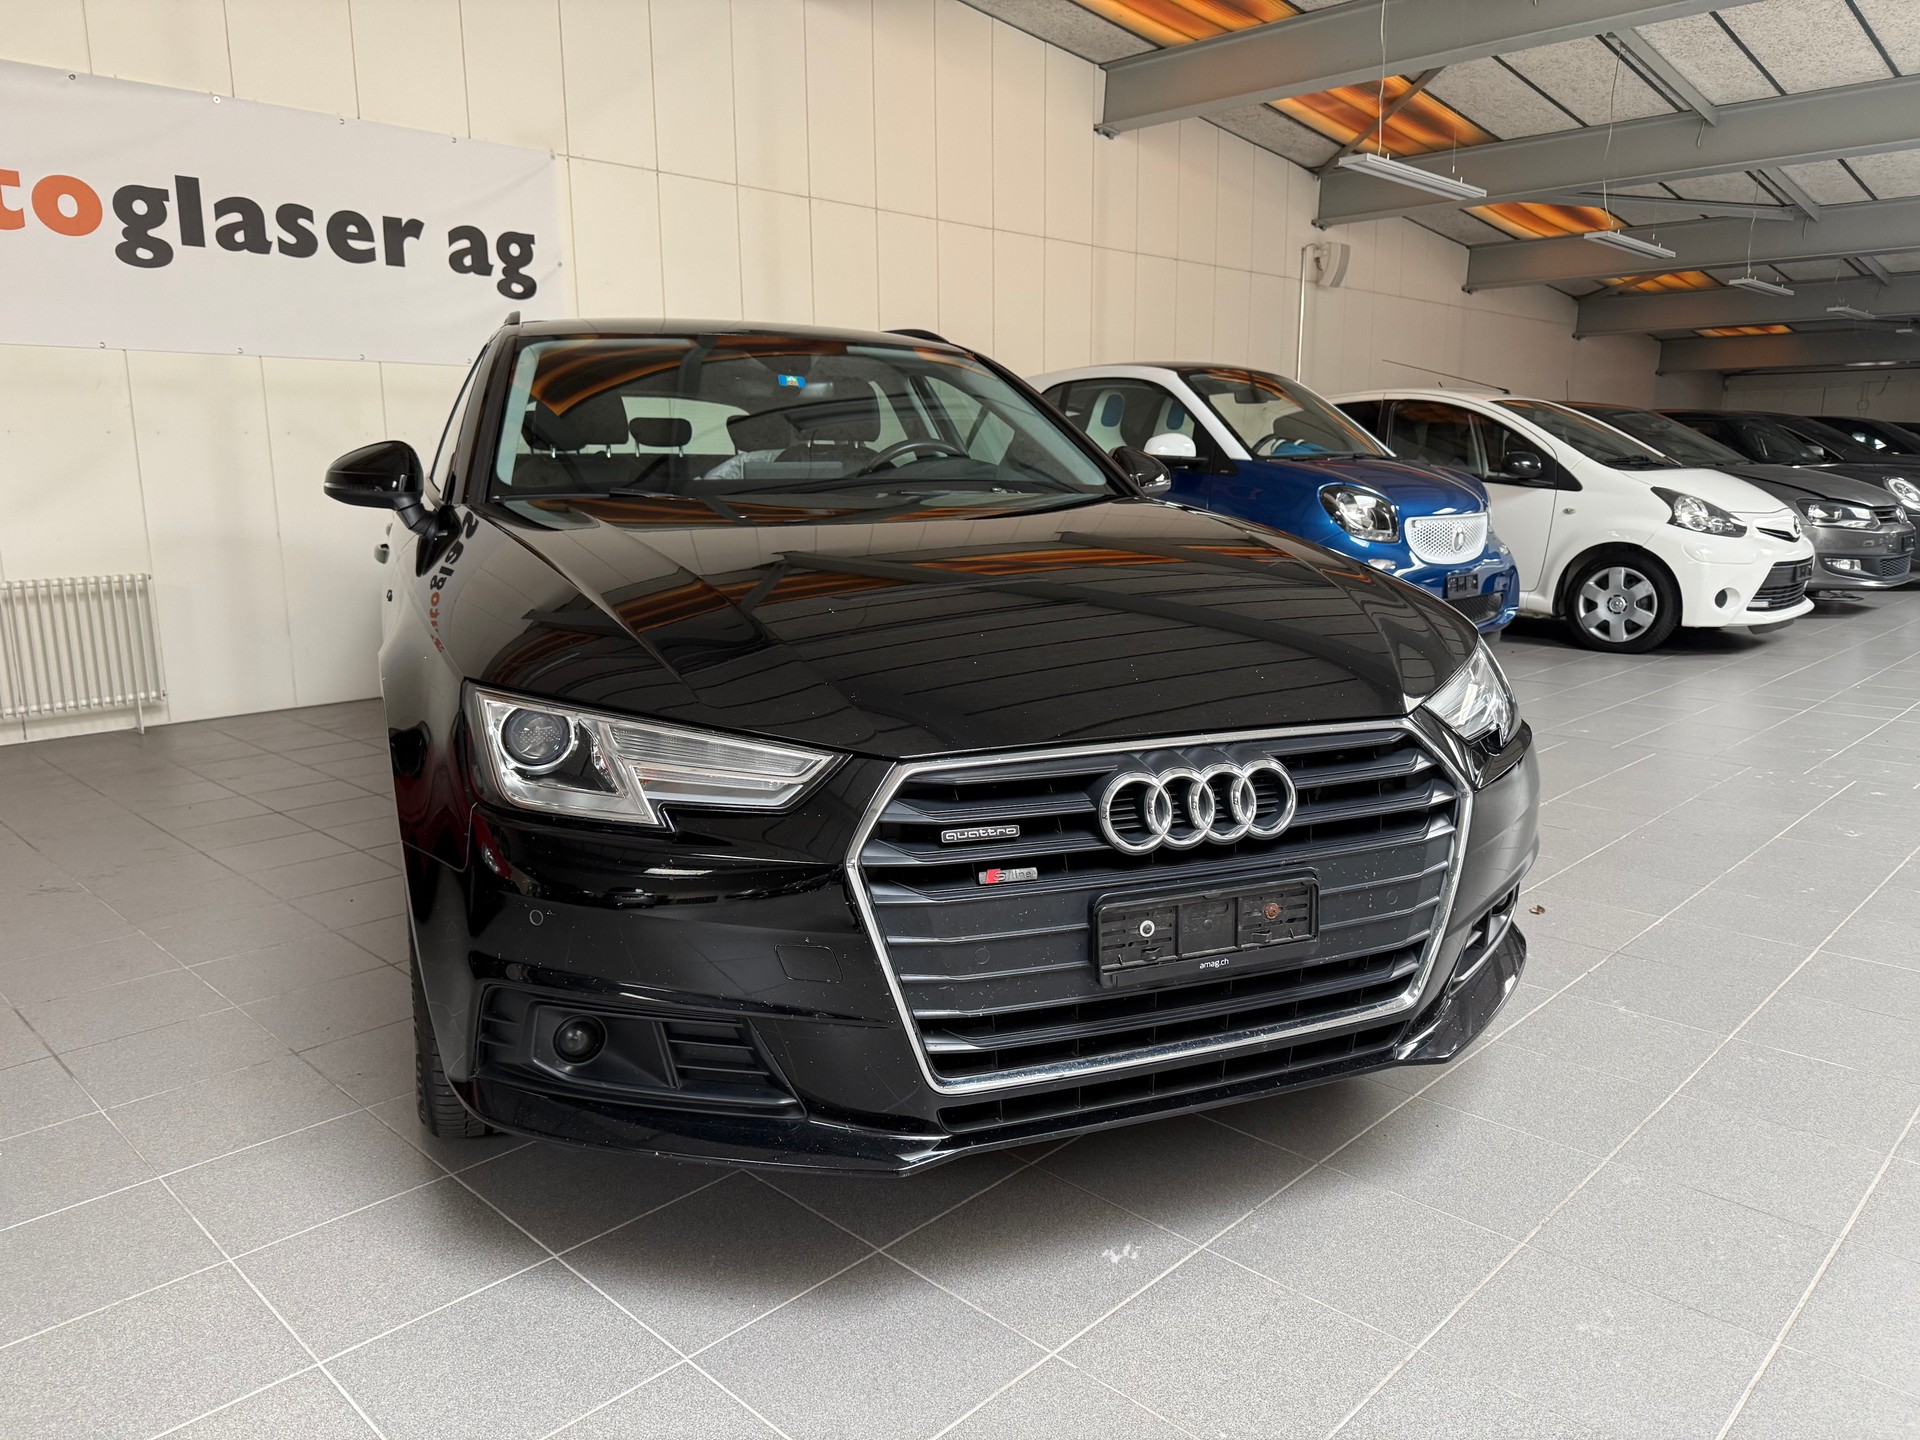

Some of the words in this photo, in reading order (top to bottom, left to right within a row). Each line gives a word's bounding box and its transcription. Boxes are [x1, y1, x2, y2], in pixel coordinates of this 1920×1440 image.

[447, 225, 537, 301] ag
[945, 827, 1017, 841] quattro
[1199, 957, 1230, 970] amag.ch
